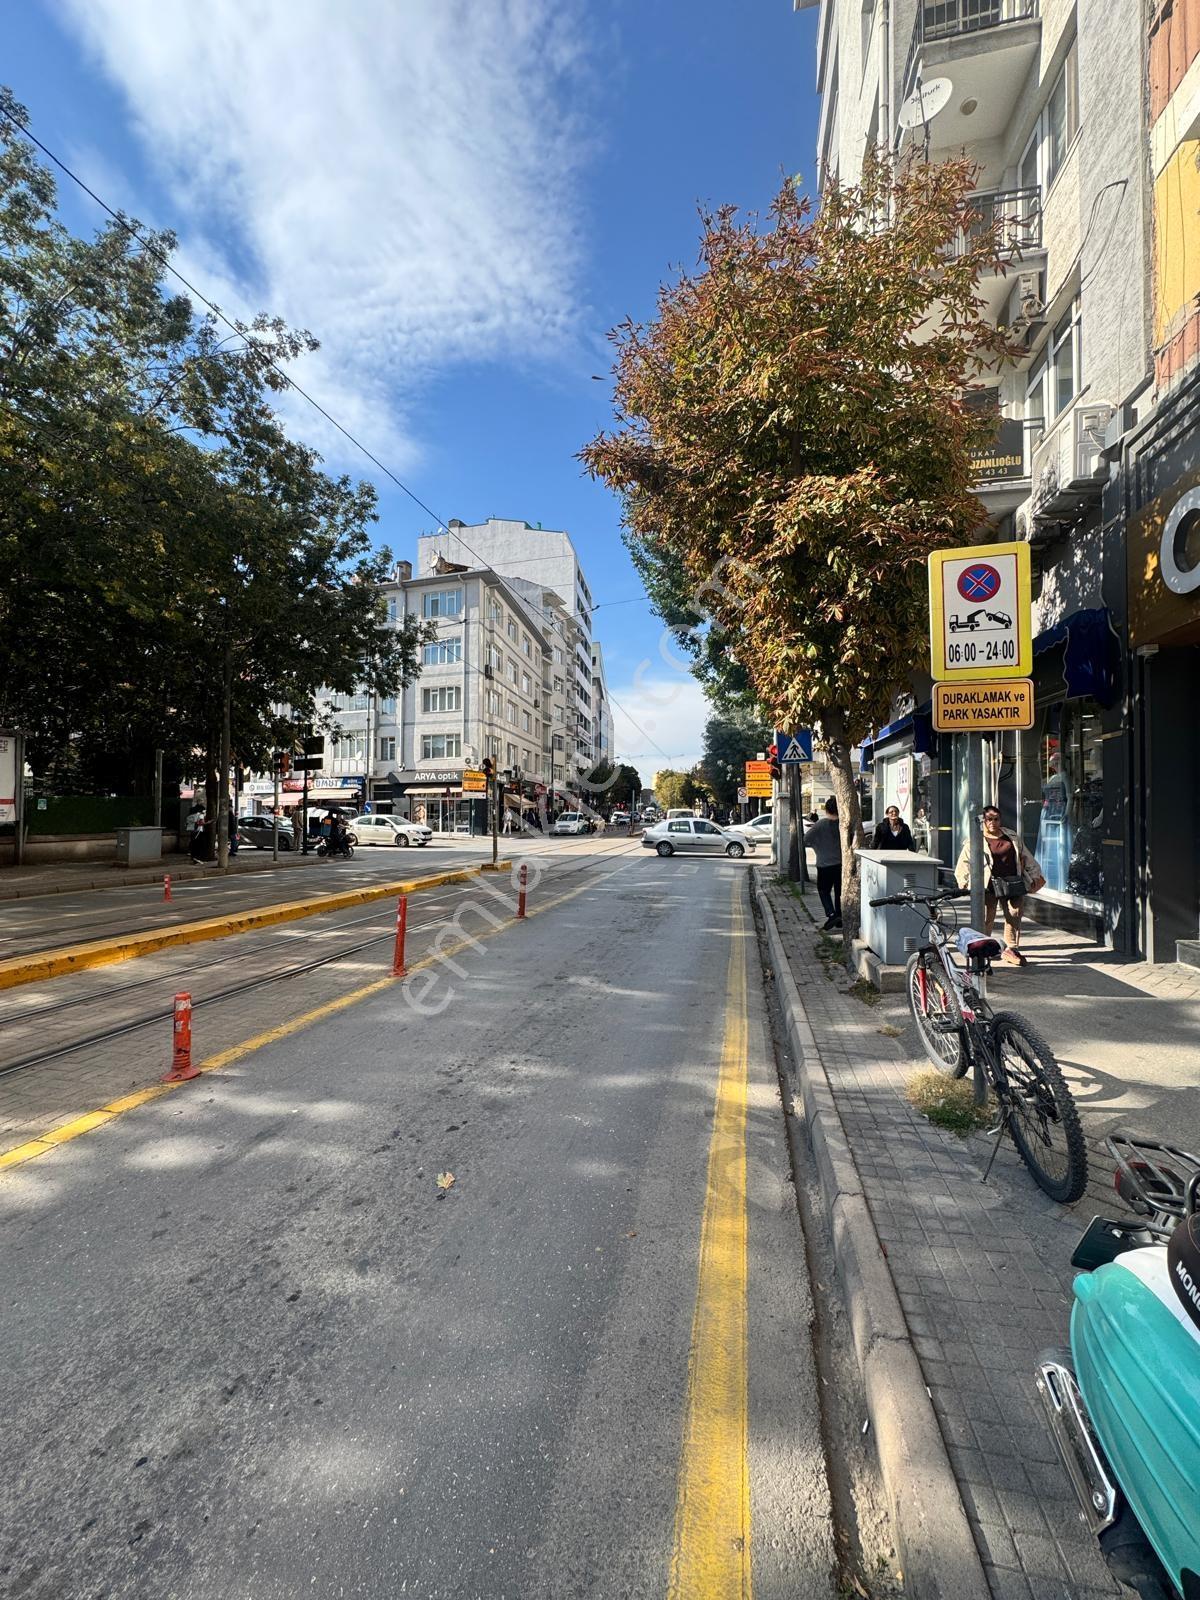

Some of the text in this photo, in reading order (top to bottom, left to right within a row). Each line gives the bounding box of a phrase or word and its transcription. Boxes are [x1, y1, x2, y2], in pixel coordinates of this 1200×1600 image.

[970, 449, 996, 458] UKAT
[943, 691, 1025, 704] DURAKLAMAK ve
[943, 707, 1020, 720] PARK YASAKTIR
[414, 772, 436, 781] ARYA
[437, 771, 458, 782] optik
